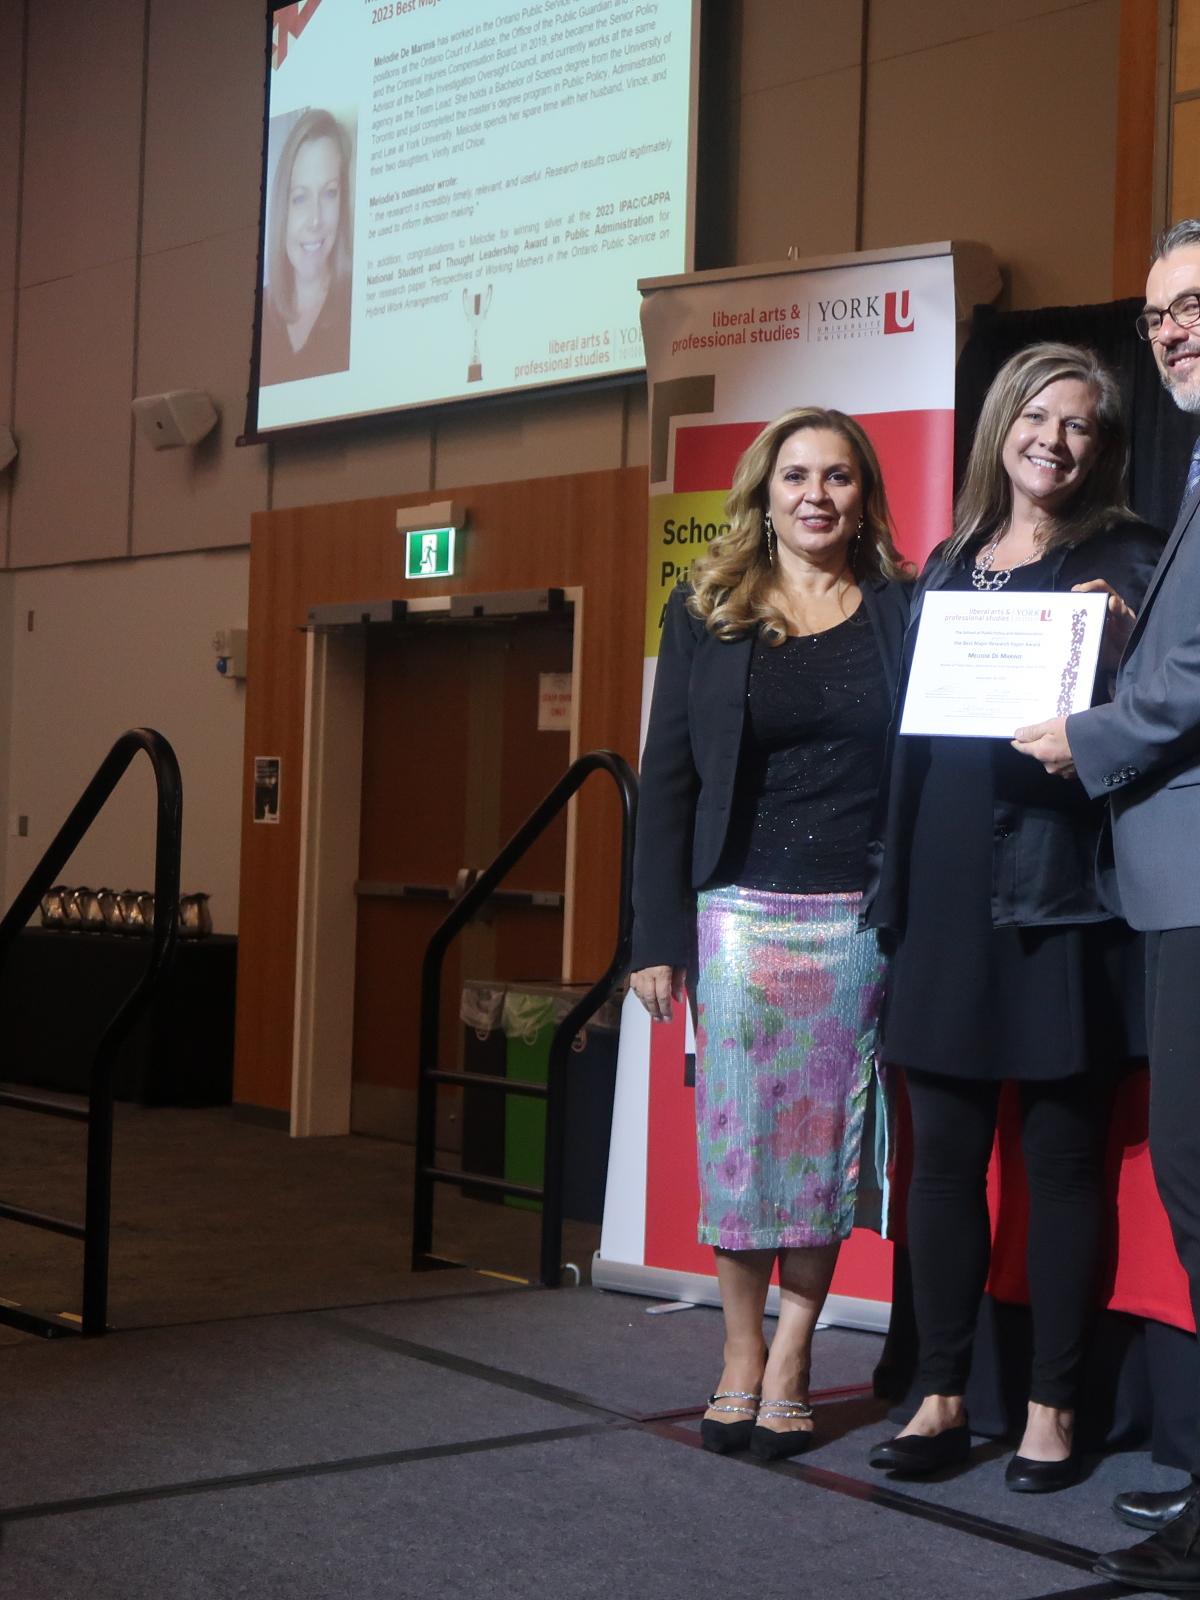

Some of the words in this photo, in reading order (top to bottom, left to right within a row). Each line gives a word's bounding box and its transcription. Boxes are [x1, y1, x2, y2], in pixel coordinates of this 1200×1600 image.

[372, 4, 393, 24] 2023
[396, 0, 415, 16] Best
[373, 67, 400, 85] positions
[420, 52, 444, 68] Ontario
[445, 46, 463, 60] Court
[499, 31, 509, 43] the
[512, 26, 532, 40] Office
[542, 18, 553, 30] the
[555, 10, 577, 26] Public
[579, 0, 612, 18] Guardian
[374, 51, 398, 67] Melodie
[401, 47, 409, 58] De
[411, 39, 435, 55] Marinis
[437, 35, 448, 46] has
[450, 25, 474, 42] worked
[483, 19, 493, 31] the
[496, 11, 520, 27] Ontario
[522, 3, 543, 19] Public
[544, 0, 570, 11] Service
[397, 73, 422, 91] Criminal
[448, 53, 495, 75] Compensation
[551, 31, 563, 44] she
[565, 22, 594, 39] became
[596, 17, 606, 30] the
[609, 10, 633, 26] Senior
[636, 3, 658, 18] Policy
[372, 99, 394, 113] Advisor
[415, 85, 434, 100] Death
[436, 75, 475, 94] Investigation
[478, 63, 510, 82] Oversight
[540, 49, 553, 63] and
[556, 40, 586, 58] currently
[588, 33, 609, 49] works
[621, 26, 633, 39] the
[635, 20, 656, 35] same
[372, 116, 393, 131] agency
[416, 104, 433, 116] Team
[455, 93, 467, 105] She
[470, 87, 487, 101] holds
[495, 76, 524, 93] Bachelor
[535, 66, 562, 82] Science
[564, 58, 589, 73] degree
[591, 52, 608, 65] from
[610, 47, 622, 59] the
[624, 36, 661, 55] University
[372, 130, 394, 145] Toronto
[409, 122, 420, 136] just
[422, 111, 454, 130] completed
[498, 94, 521, 109] degree
[523, 85, 552, 104] program
[562, 75, 584, 90] Public
[612, 52, 666, 76] Administration
[384, 146, 396, 157] Law
[406, 137, 420, 151] York
[456, 121, 481, 137] Melodie
[484, 114, 507, 131] spends
[509, 111, 521, 122] her
[522, 105, 541, 120] spare
[543, 100, 558, 112] time
[561, 93, 574, 108] with
[577, 92, 588, 103] her
[626, 75, 650, 89] Vince,
[652, 67, 667, 82] and
[369, 190, 400, 207] Melodie's
[402, 182, 435, 199] nominator
[437, 176, 458, 189] wrote:
[386, 202, 413, 218] research
[421, 193, 451, 210] incredibly
[505, 175, 518, 189] and
[545, 160, 578, 179] Research
[581, 155, 605, 170] results
[607, 148, 627, 163] could
[629, 138, 672, 159] legitimately
[378, 223, 392, 236] used
[402, 218, 420, 230] inform
[422, 211, 448, 225] decision
[407, 242, 454, 260] congratulations
[469, 231, 495, 246] Melodie
[500, 229, 508, 239] for
[513, 222, 540, 236] winning
[544, 217, 562, 229] silver
[579, 209, 591, 221] the
[596, 203, 614, 217] 2023
[620, 190, 671, 212] IPAC/CAPPA
[367, 270, 393, 286] National
[398, 264, 424, 279] Student
[428, 259, 441, 272] and
[446, 252, 474, 268] Thought
[479, 243, 519, 260] Leadership
[524, 235, 548, 251] Award
[565, 227, 589, 242] Public
[595, 214, 654, 235] Administration
[659, 210, 669, 221] for
[378, 283, 405, 298] research
[486, 262, 512, 276] Working
[516, 255, 544, 269] Mothers
[556, 249, 568, 260] the
[571, 242, 598, 257] Ontario
[601, 236, 624, 251] Public
[628, 231, 656, 245] Service
[366, 303, 385, 319] Hybrid
[712, 308, 755, 328] liberal
[760, 307, 786, 324] arts
[790, 304, 800, 320] &
[818, 296, 880, 322] YORK
[548, 336, 579, 354] liberal
[581, 333, 601, 349] arts
[604, 330, 610, 345] &
[672, 330, 747, 356] professional
[750, 326, 800, 344] studies
[817, 320, 881, 333] UNIVERSITÉ
[817, 330, 881, 342] UNIVERSITY
[514, 356, 572, 379] professional
[574, 350, 610, 368] studies
[661, 559, 695, 586] Pu
